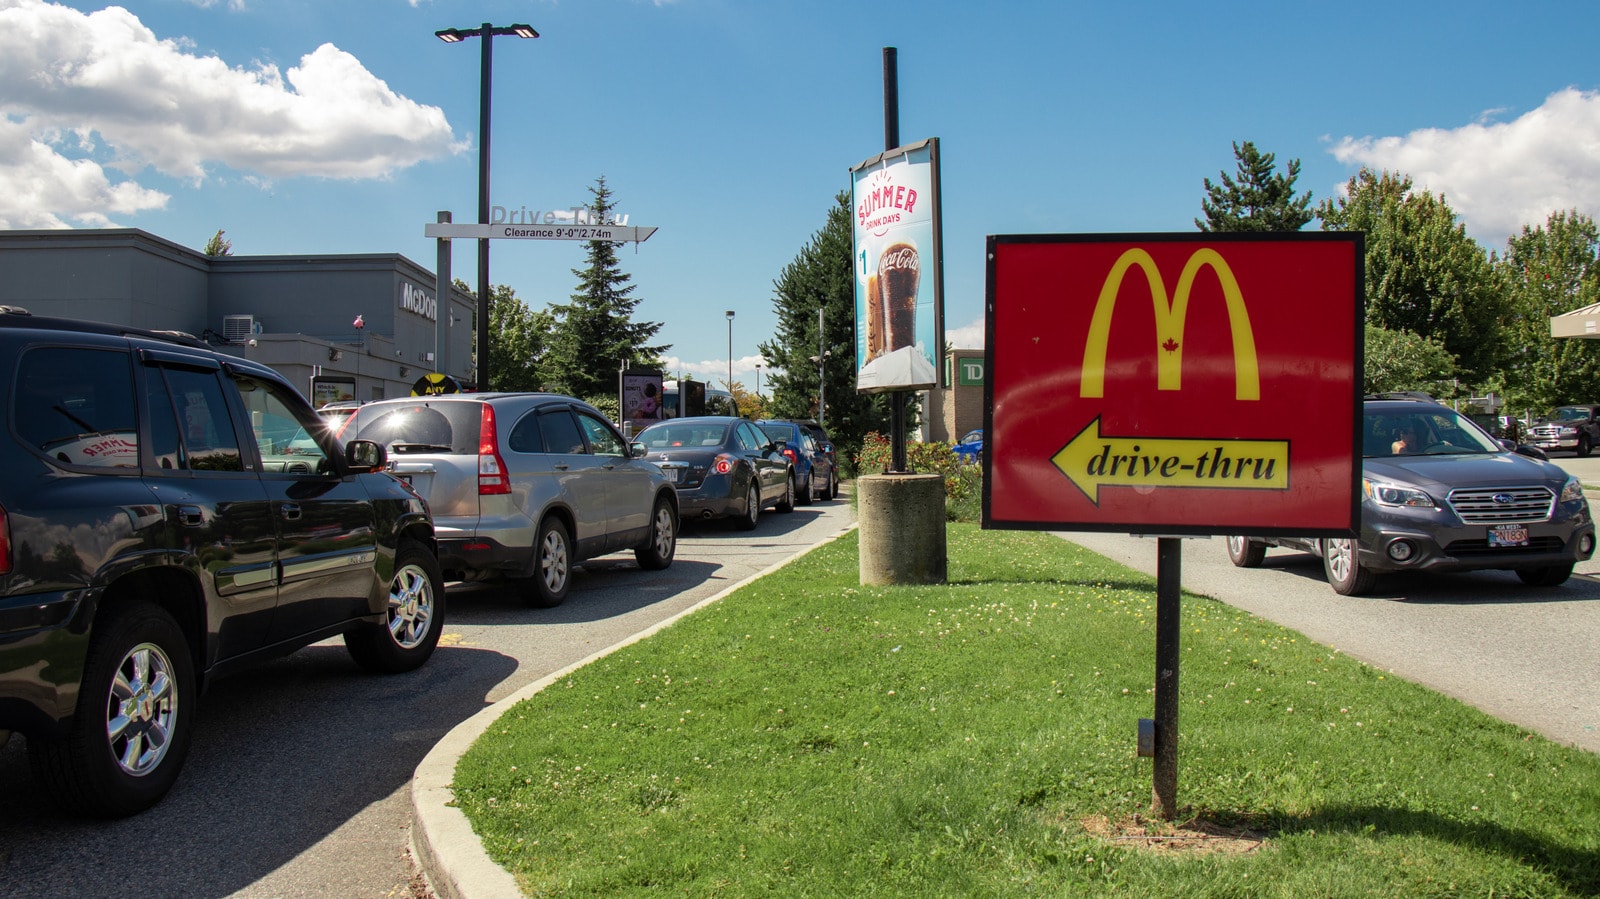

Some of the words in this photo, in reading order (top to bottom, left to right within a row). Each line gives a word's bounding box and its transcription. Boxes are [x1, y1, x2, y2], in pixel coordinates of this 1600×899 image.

[858, 185, 918, 226] SUMMER
[866, 217, 882, 231] DRINK
[882, 213, 901, 225] DAYS
[504, 227, 553, 238] Clearance
[556, 228, 612, 239] 9'-0"/2.74m
[880, 247, 919, 275] Coca-Cola
[963, 363, 984, 380] TD
[425, 386, 445, 395] ANY
[1086, 444, 1276, 481] drive-thru
